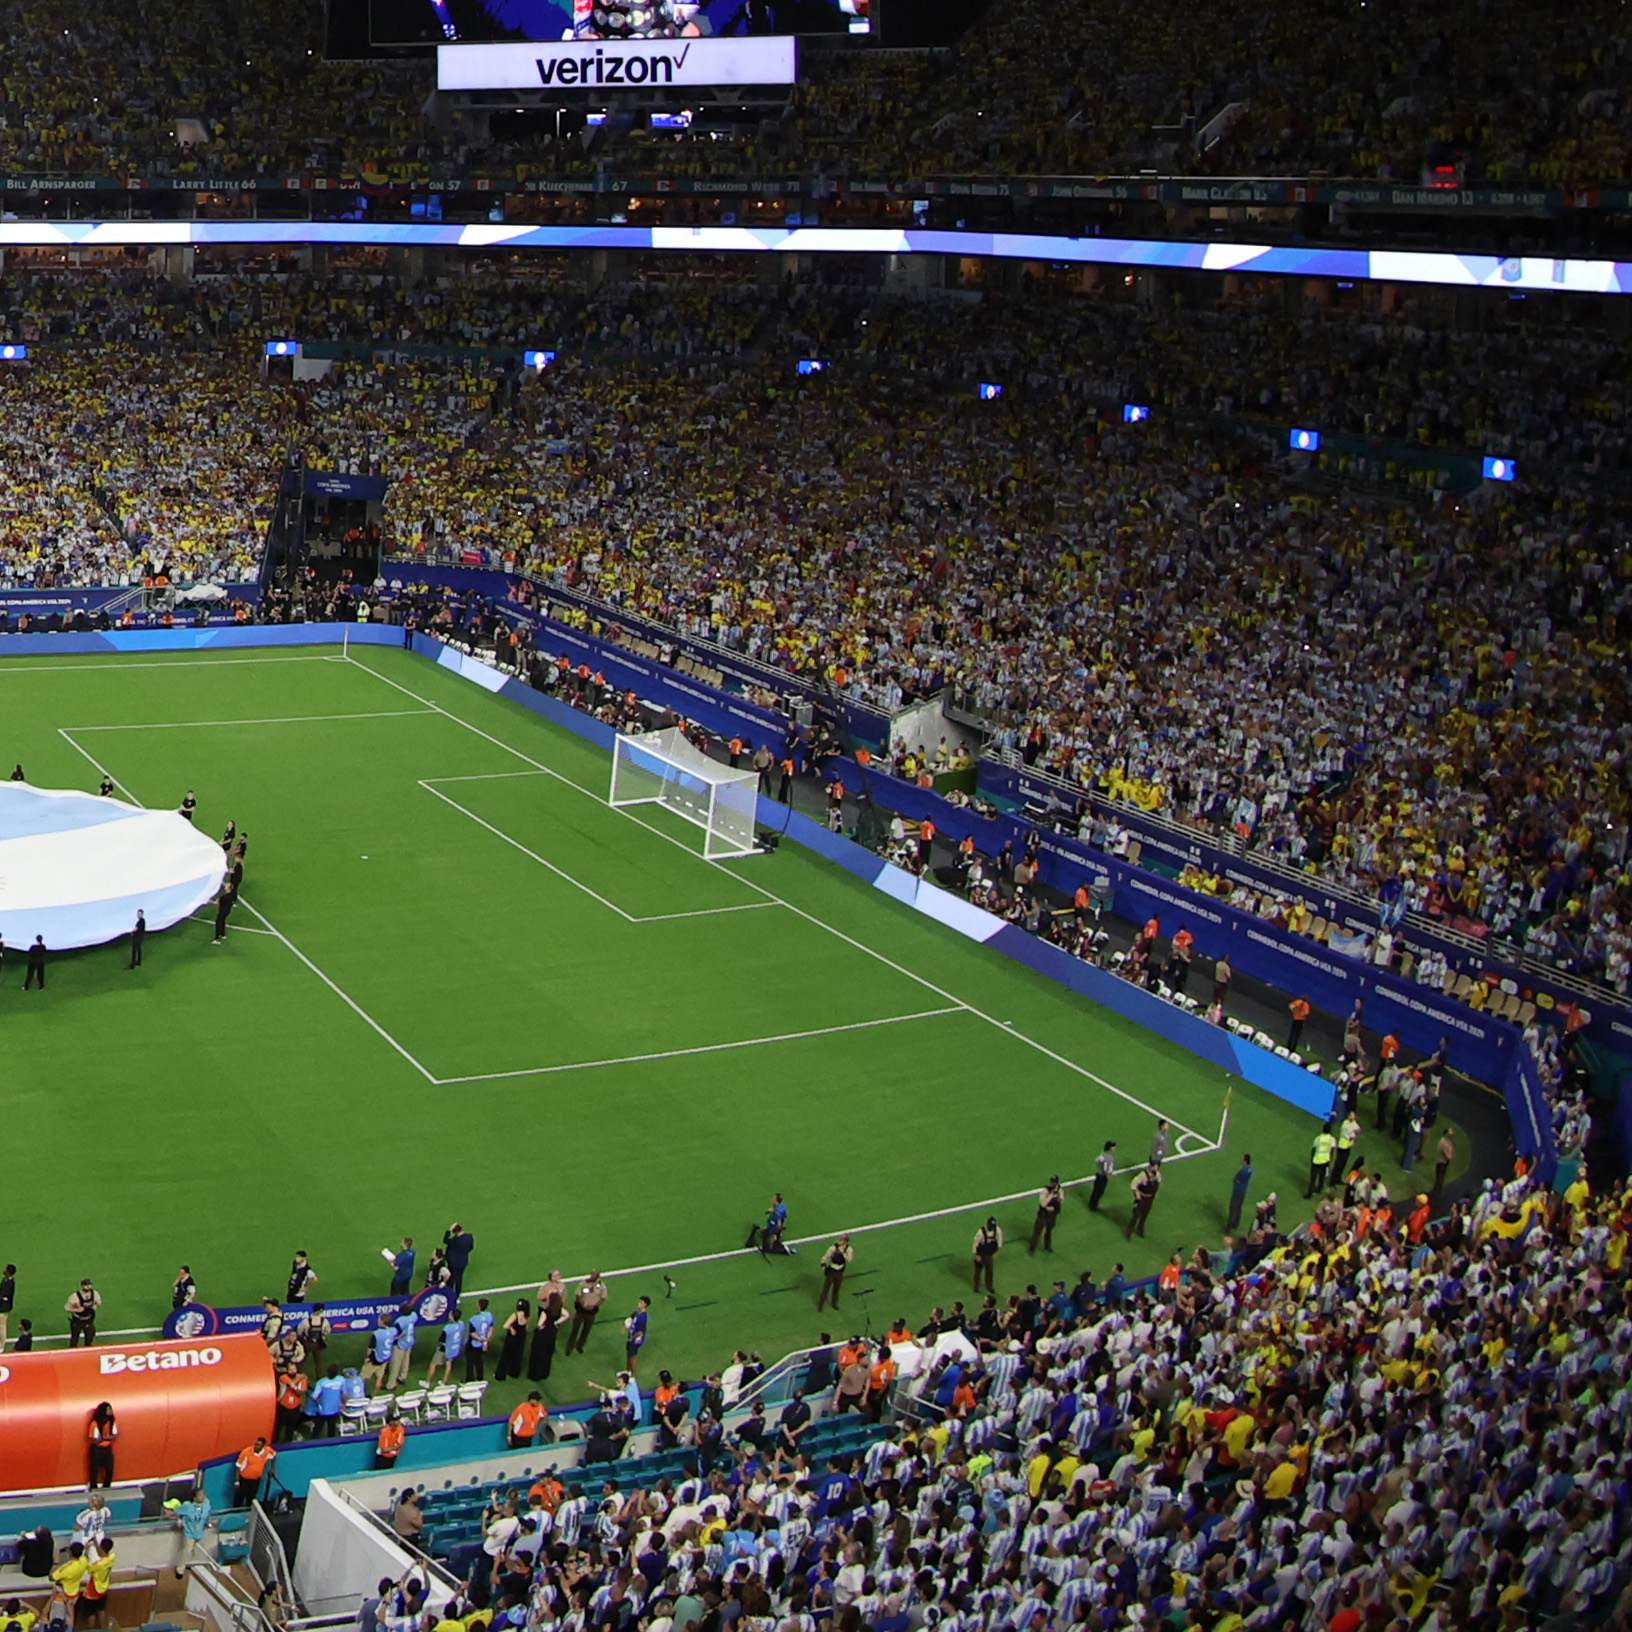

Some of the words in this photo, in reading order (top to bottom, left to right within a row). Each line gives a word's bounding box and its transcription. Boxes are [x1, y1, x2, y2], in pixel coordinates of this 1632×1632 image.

[536, 49, 674, 85] verizon
[6, 179, 26, 189] BILL
[29, 179, 96, 189] ARNSPARGER
[172, 179, 205, 189] LARRY
[209, 179, 239, 189] LITTLE
[241, 179, 257, 189] 66
[611, 181, 627, 192] 67
[1416, 191, 1458, 205] MARINO
[1462, 191, 1474, 205] 13
[1247, 930, 1279, 951] CONMEBOL
[1279, 943, 1295, 958] COPA
[1295, 950, 1321, 969] AMERICA
[1321, 960, 1332, 973] USA
[1333, 965, 1347, 979] 2024
[1375, 985, 1410, 1008] CONMEBOL
[1410, 999, 1427, 1015] COPA
[1428, 1007, 1456, 1026] AMERICA
[1456, 1018, 1468, 1032] USA
[1469, 1024, 1484, 1038] 2024
[356, 1305, 374, 1315] USA
[99, 1347, 223, 1374] Betano
